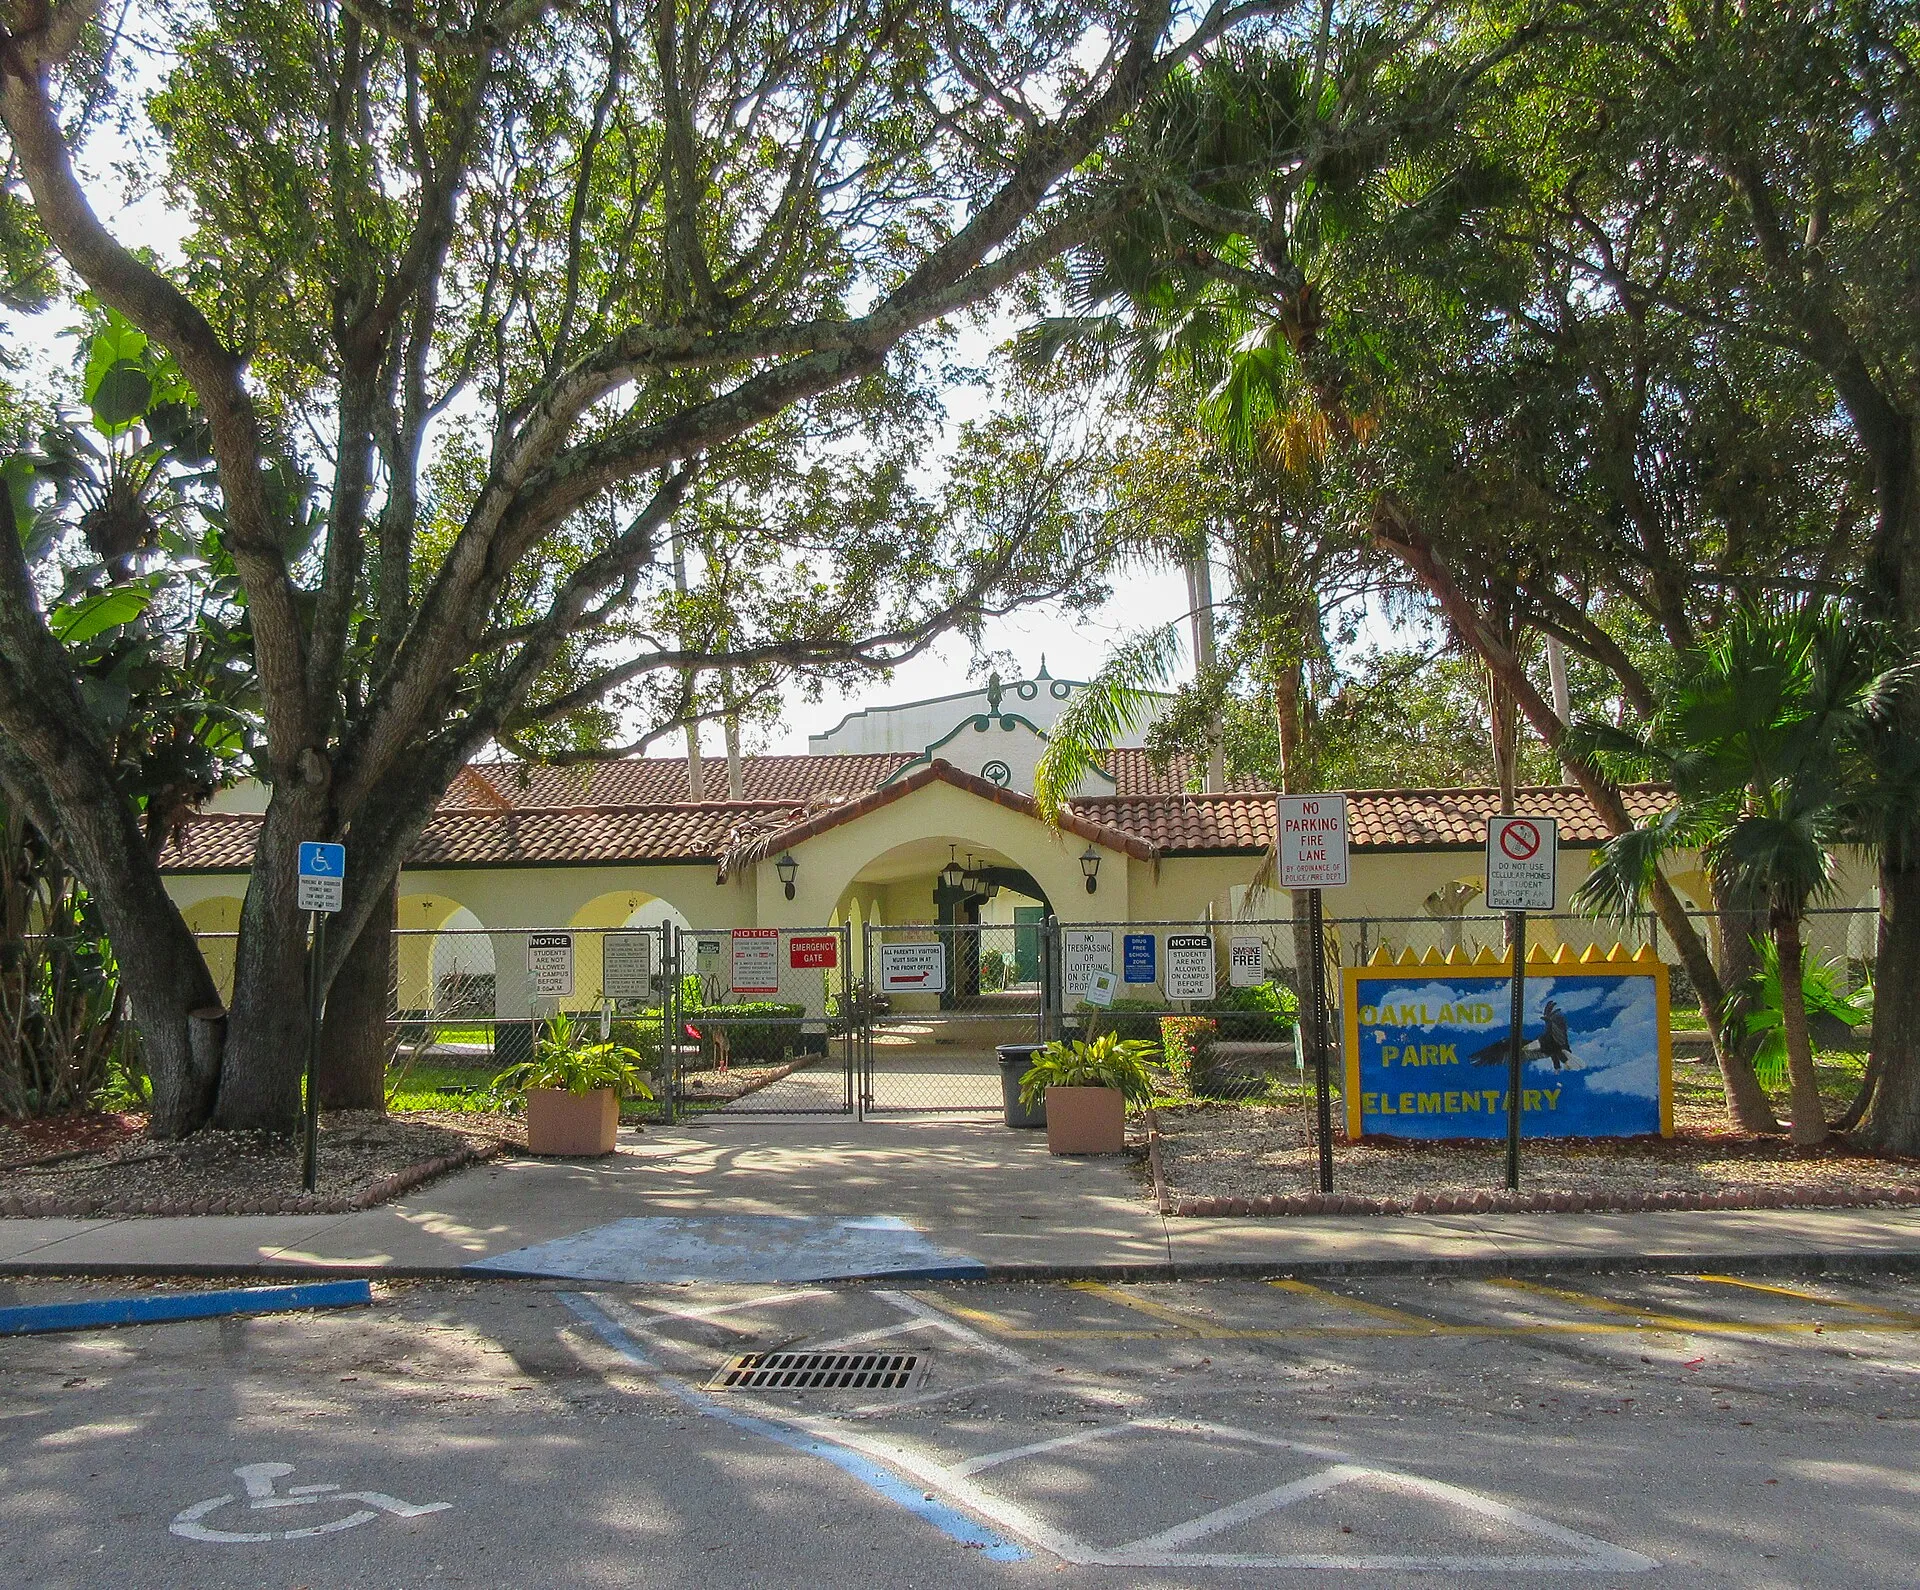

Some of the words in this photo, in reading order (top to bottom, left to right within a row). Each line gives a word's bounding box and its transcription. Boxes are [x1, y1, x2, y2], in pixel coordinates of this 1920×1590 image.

[1303, 802, 1319, 814] NO
[1286, 818, 1338, 832] PARKING
[1301, 835, 1324, 846] FIRE
[1299, 850, 1326, 861] LANE
[1286, 865, 1293, 873] BY
[1297, 864, 1330, 872] ORDINANCE
[1499, 862, 1509, 870] DO
[1530, 863, 1544, 871] USE
[1526, 872, 1551, 880] PHONES
[1493, 889, 1529, 897] DROP-OFF
[1494, 898, 1522, 906] PICK-UP
[532, 938, 567, 946] NOTICE
[1084, 934, 1094, 942] NO
[1171, 938, 1208, 947] NOTICE
[792, 942, 835, 952] EMERGENCY
[1068, 944, 1112, 952] TRESPASSING
[1233, 947, 1260, 955] SMOKE
[804, 954, 823, 963] GATE
[1084, 953, 1094, 962] OR
[1233, 955, 1261, 966] FREE
[1068, 973, 1077, 981] ON
[1359, 1002, 1495, 1027] OAKLAND
[1382, 1043, 1459, 1068] PARK
